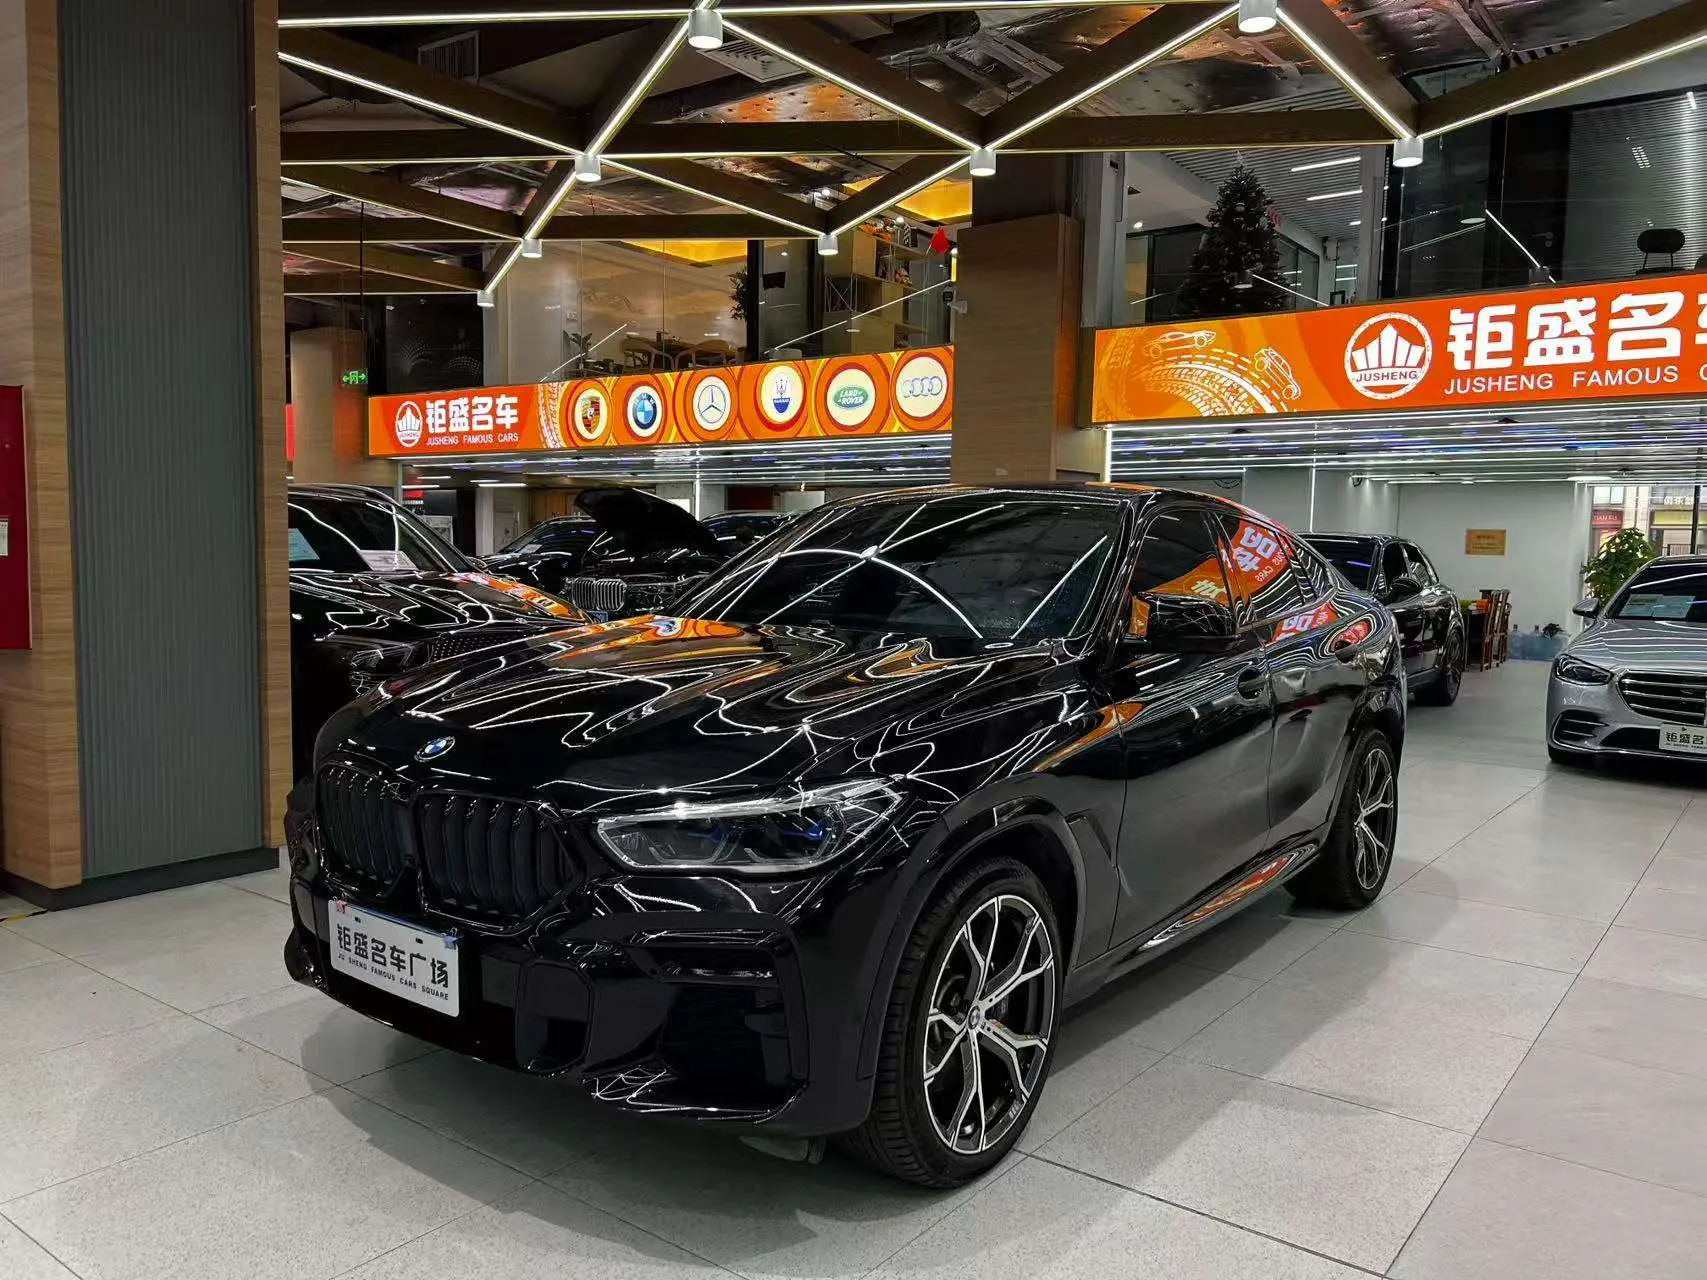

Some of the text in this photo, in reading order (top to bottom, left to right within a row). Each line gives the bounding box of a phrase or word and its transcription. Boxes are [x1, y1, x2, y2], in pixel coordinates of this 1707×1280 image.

[1447, 291, 1707, 371] 钜盛名
[1356, 371, 1418, 383] JUSHENG
[1444, 373, 1553, 395] JUSHENG
[1572, 365, 1679, 388] FAMOUS
[839, 389, 858, 398] LAND
[841, 396, 864, 405] ROVER
[425, 394, 519, 433] 钜盛名车
[426, 432, 519, 446] JUSHENG FAMOUS CARS
[337, 923, 449, 988] 钜盛名车广场
[348, 956, 368, 970] SHENG
[371, 966, 396, 981] FAMOUS
[399, 977, 417, 990] CARS
[421, 985, 449, 1001] SQUARE
